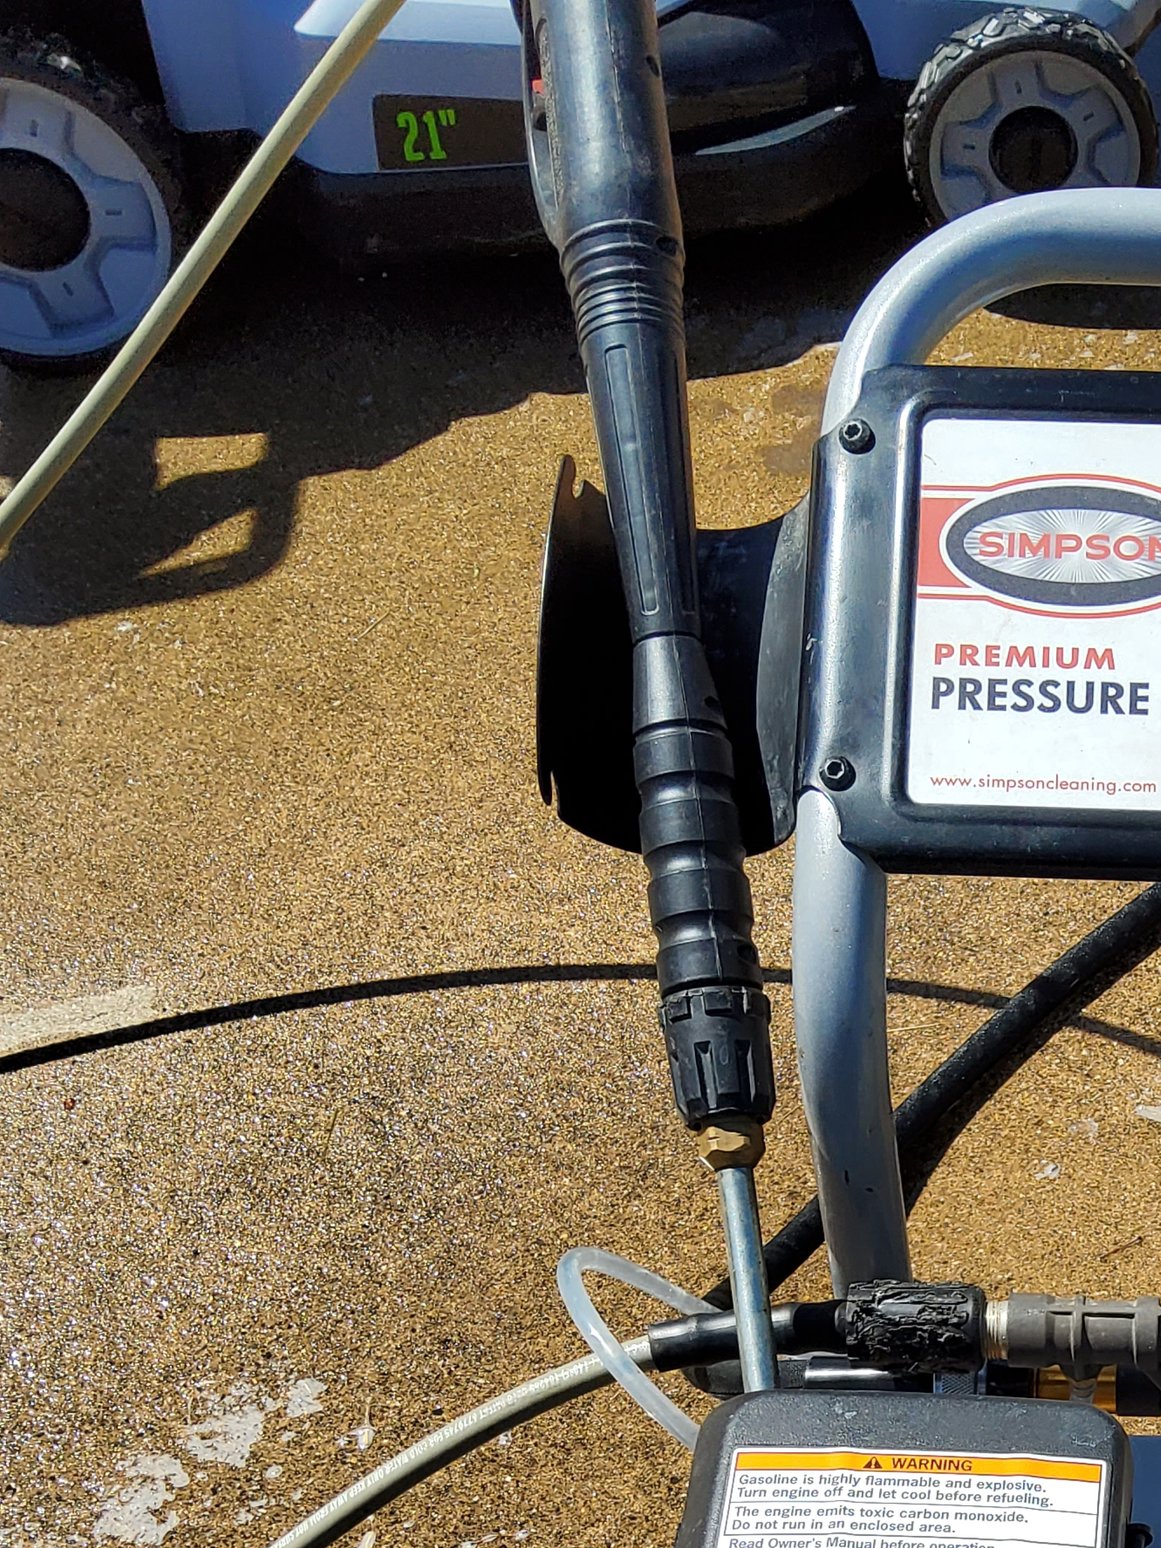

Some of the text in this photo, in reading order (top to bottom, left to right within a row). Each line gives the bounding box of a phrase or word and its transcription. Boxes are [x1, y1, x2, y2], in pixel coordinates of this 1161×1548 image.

[934, 643, 1116, 671] PREMIUM
[930, 677, 1150, 716] PRESSURE
[930, 773, 1157, 795] www.simpsoncleaning.com
[892, 1458, 973, 1472] WARNING
[739, 1474, 1047, 1493] Gasoline is highly flammable and explosive.
[738, 1487, 1053, 1508] Turn engine off and let cool before refueling.
[735, 1505, 1029, 1523] The engine emits toxic carbon monoxide.
[732, 1519, 956, 1533] Do not run in an enclosed area.
[729, 1538, 764, 1548] Read
[768, 1538, 822, 1548] Owner's
